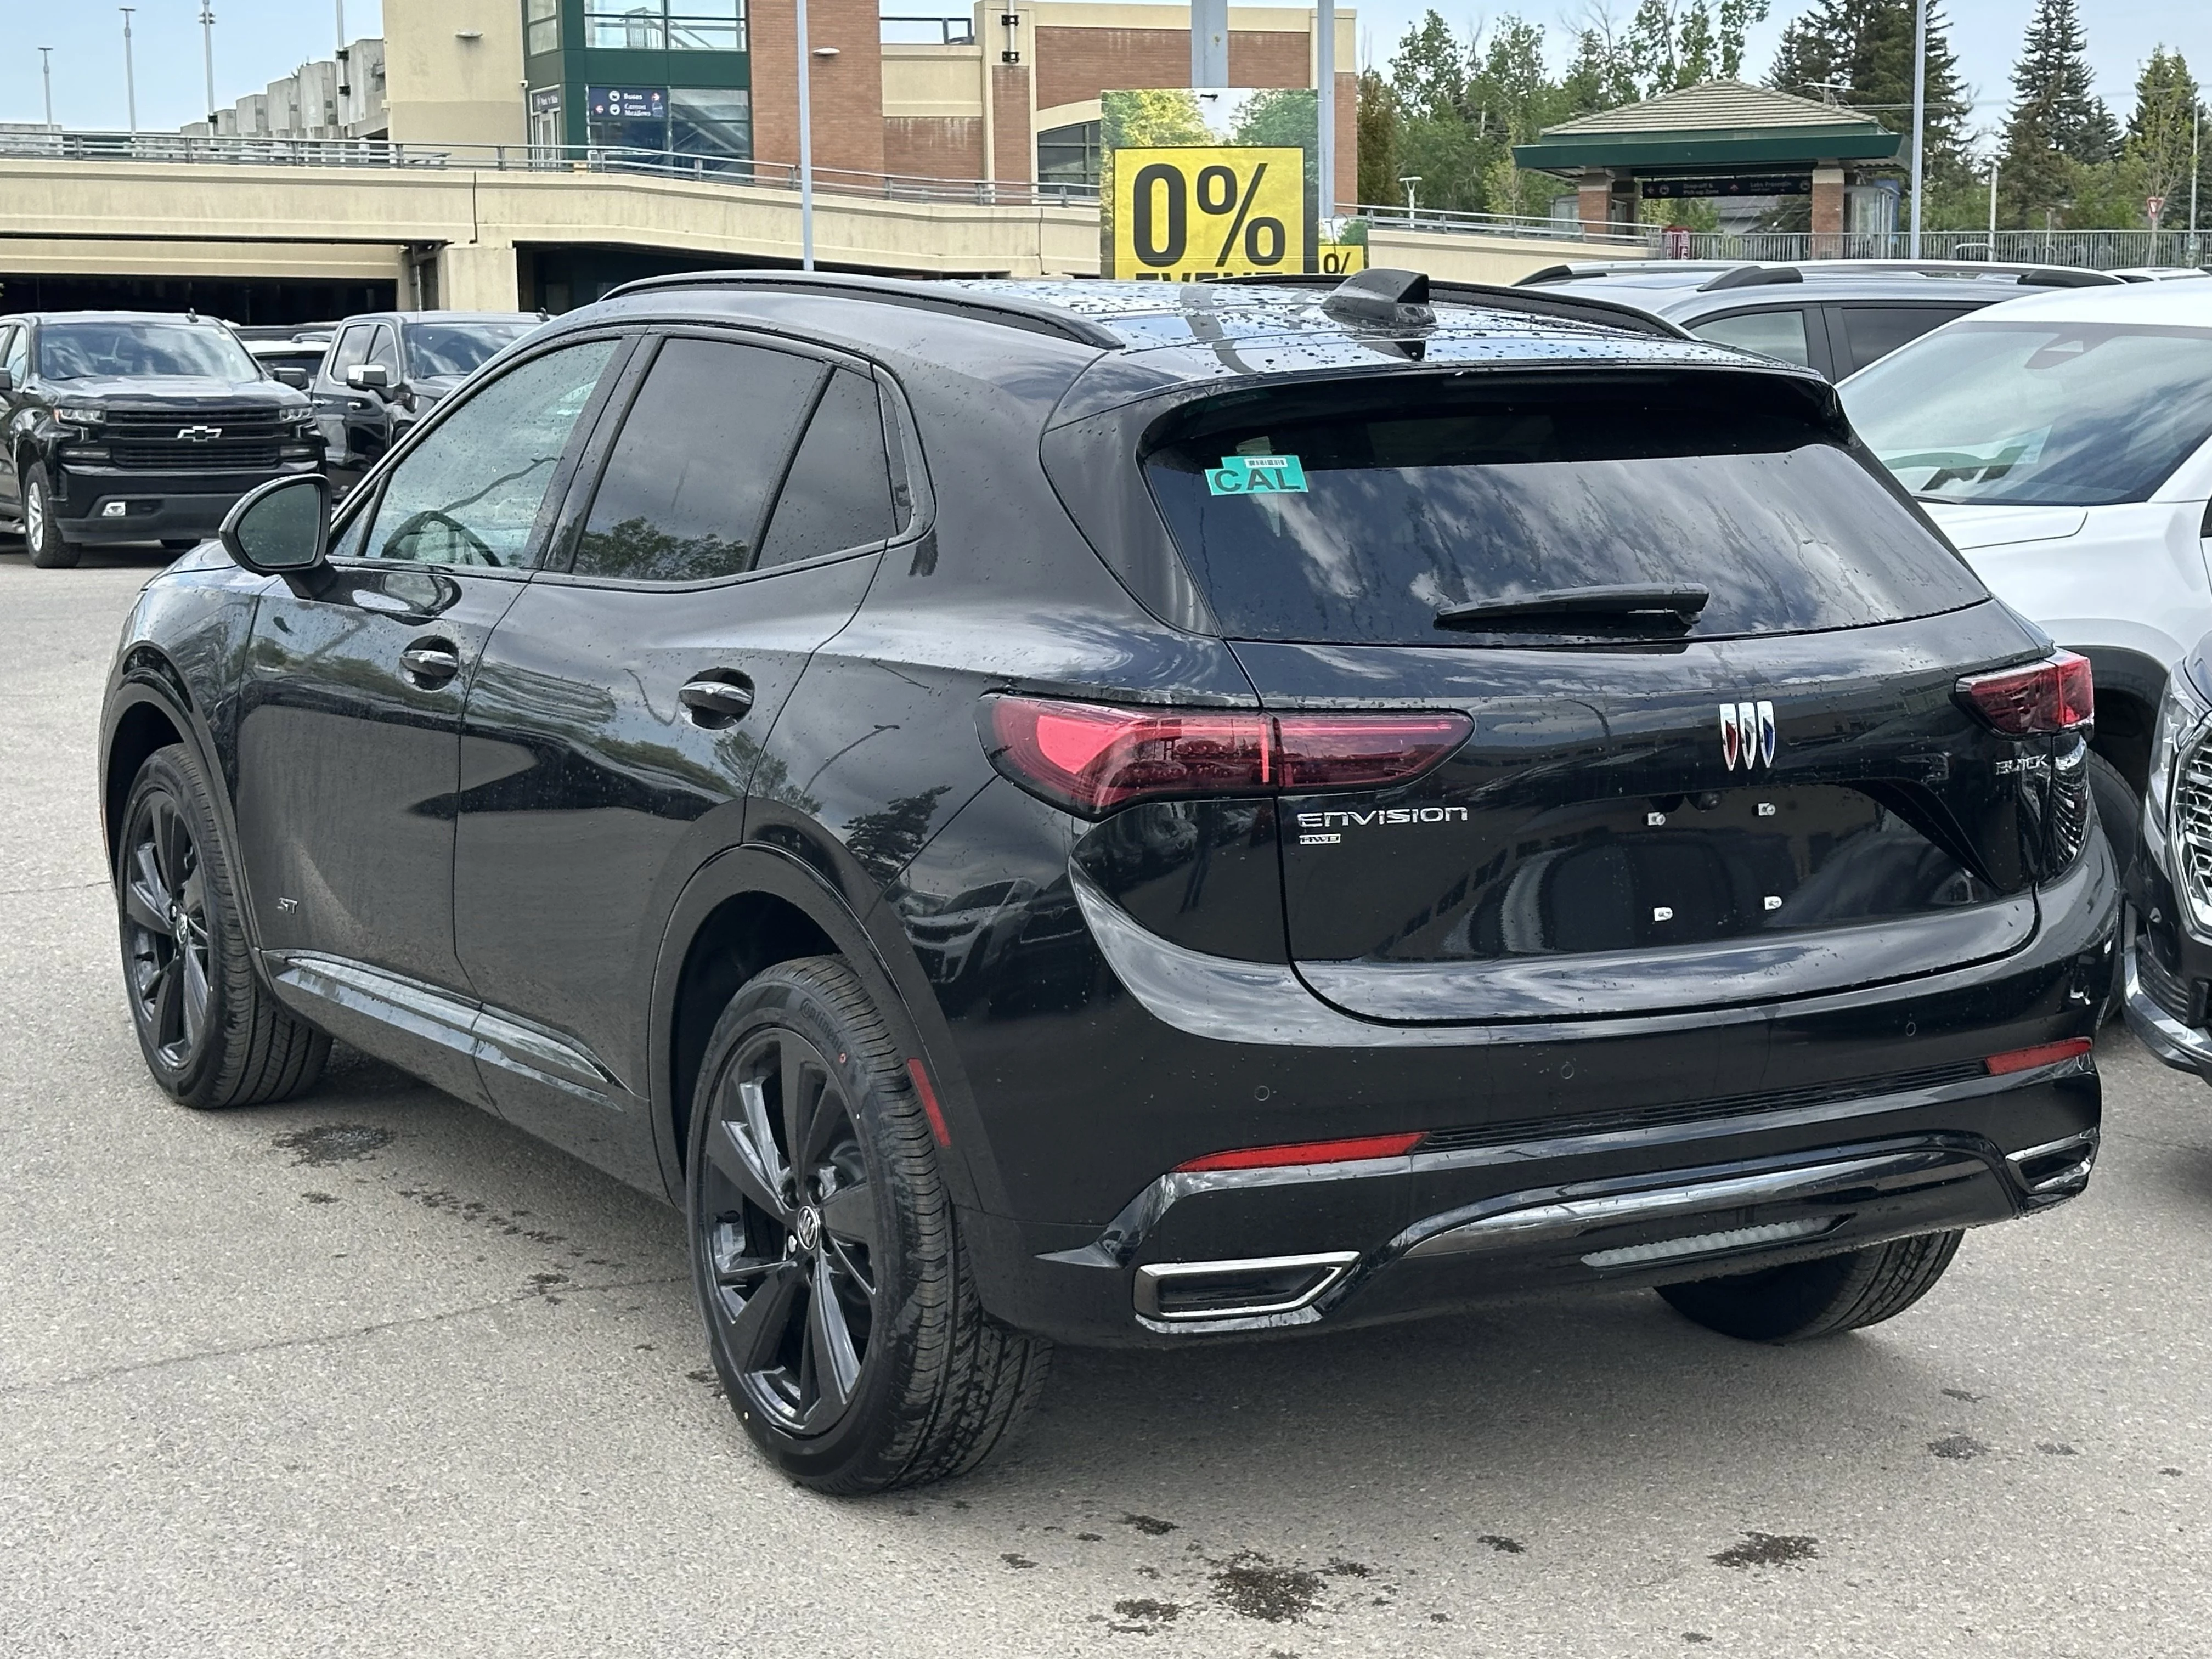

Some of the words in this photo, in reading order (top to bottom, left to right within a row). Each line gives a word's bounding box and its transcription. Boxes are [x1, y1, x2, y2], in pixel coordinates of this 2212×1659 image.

[1133, 162, 1286, 268] 0%
[1214, 469, 1301, 493] CAL
[1296, 806, 1469, 828] ENVISION
